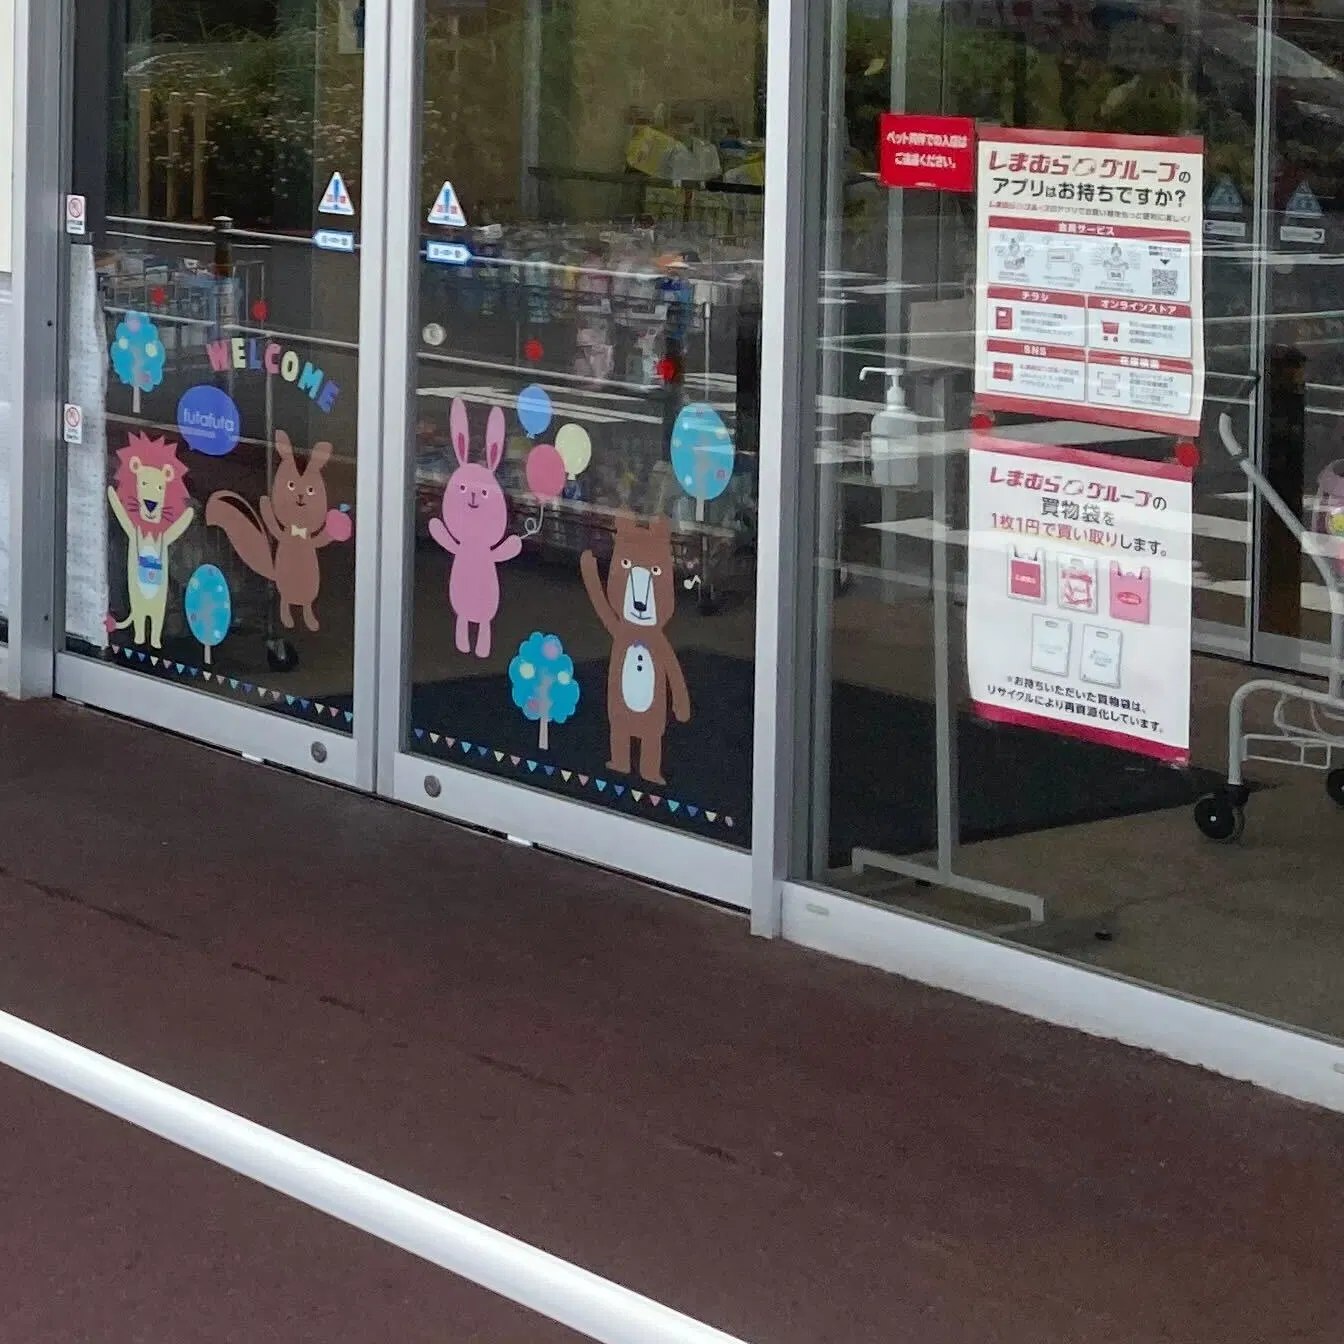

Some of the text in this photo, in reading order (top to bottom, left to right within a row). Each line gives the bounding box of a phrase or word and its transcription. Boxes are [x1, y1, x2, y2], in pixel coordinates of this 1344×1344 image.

[1100, 299, 1177, 316] オンラインストア
[206, 337, 340, 415] WELCOME
[1040, 496, 1116, 527] 買物袋を
